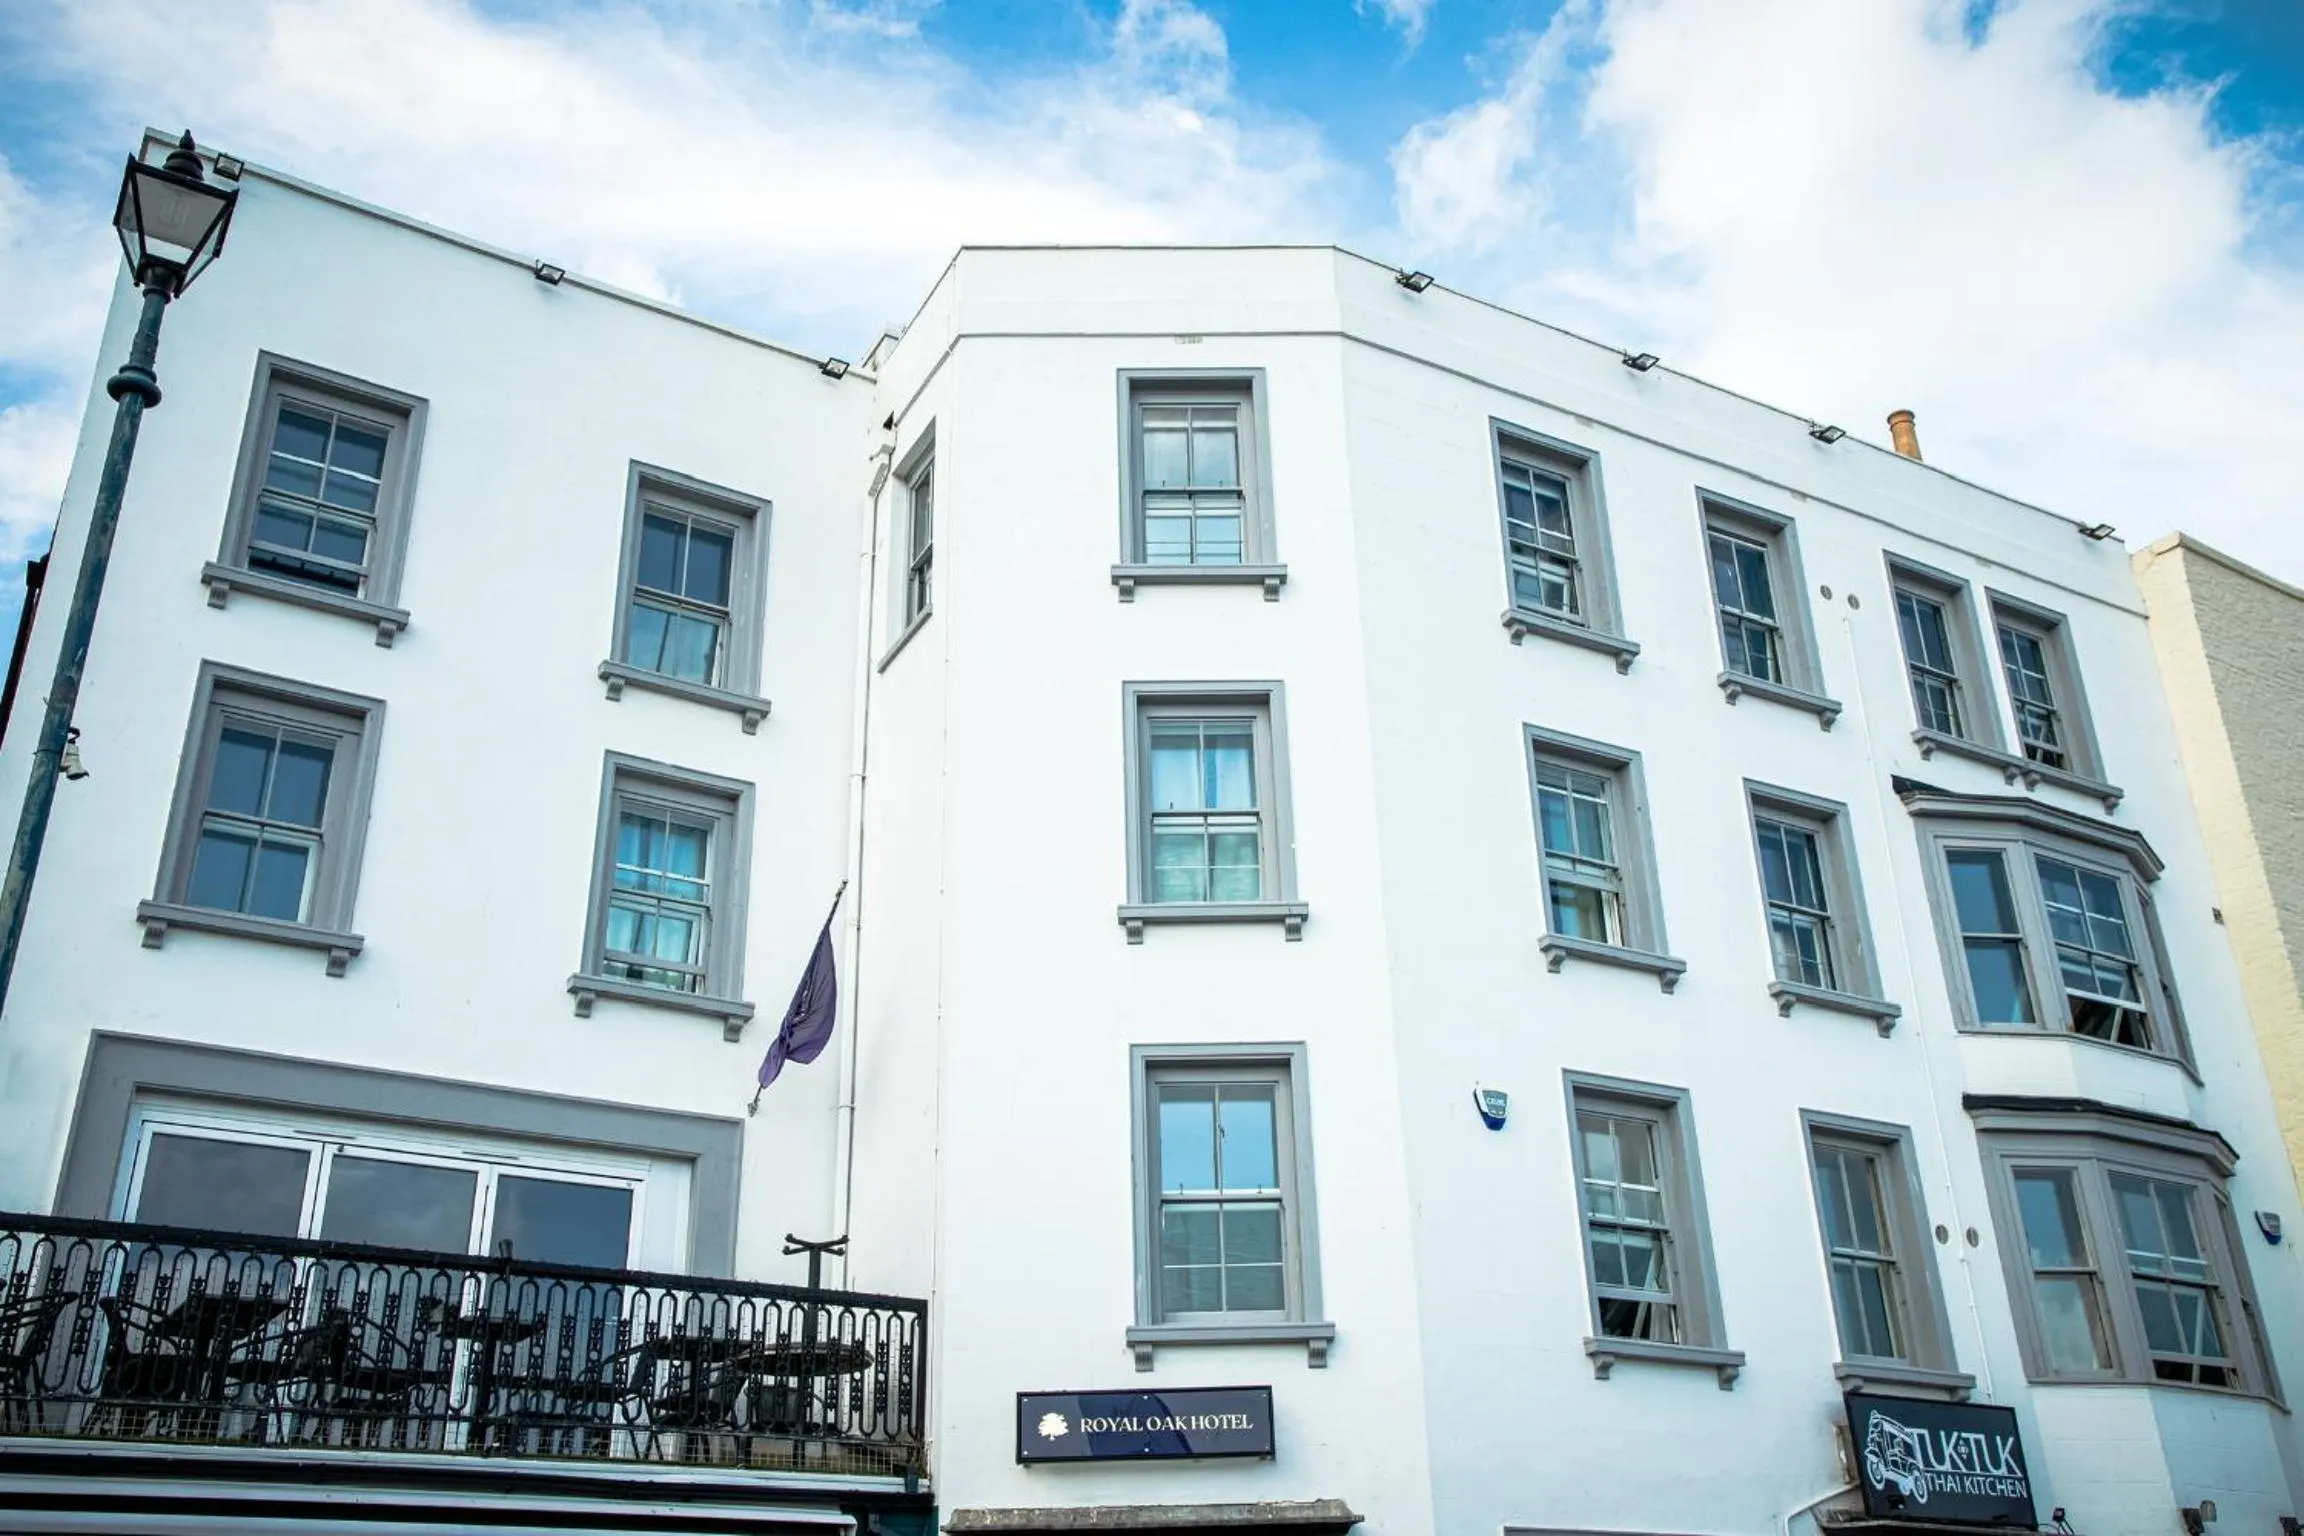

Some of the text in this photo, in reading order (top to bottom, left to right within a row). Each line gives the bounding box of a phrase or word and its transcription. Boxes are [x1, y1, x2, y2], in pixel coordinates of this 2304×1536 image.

[1080, 1414, 1254, 1433] ROYAL OAK HOTEL
[1924, 1472, 2028, 1499] THAI KITCHEN
